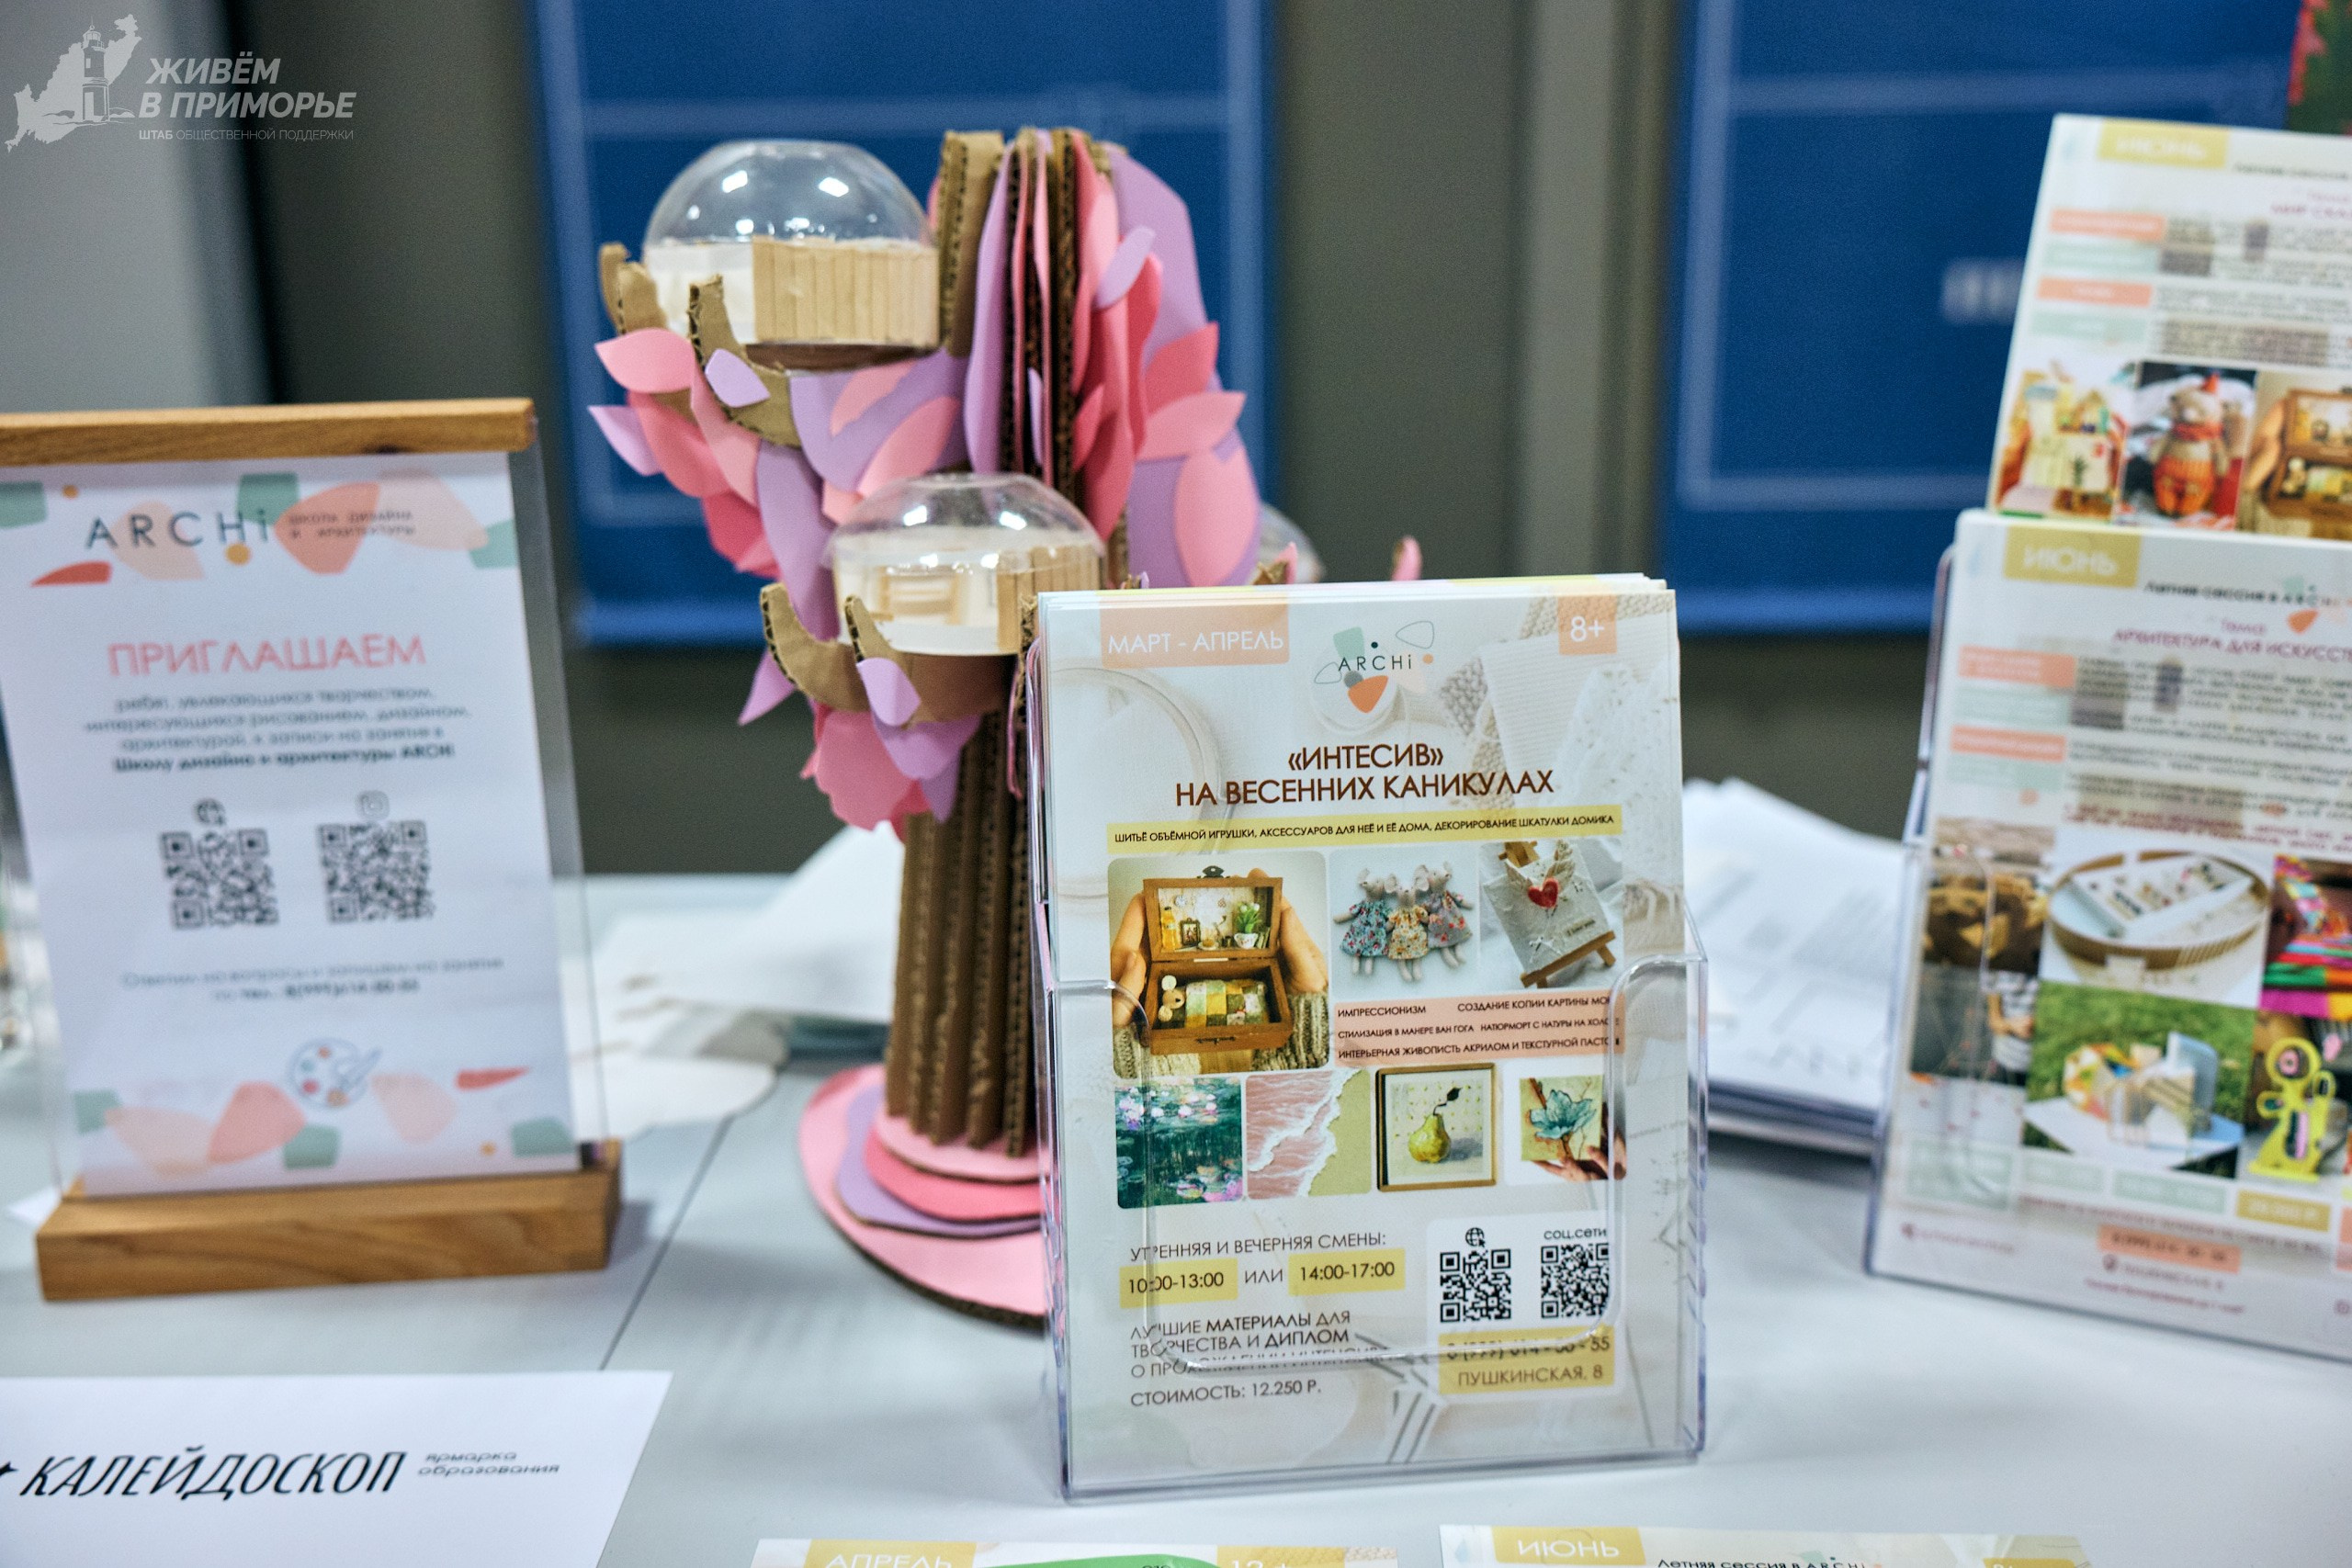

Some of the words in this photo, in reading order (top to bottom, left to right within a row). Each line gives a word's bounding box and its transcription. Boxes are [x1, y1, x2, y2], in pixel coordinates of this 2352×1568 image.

[1570, 615, 1605, 642] 8+
[1108, 632, 1171, 654] МАРТ
[1193, 629, 1284, 652] АПРЕЛЬ
[107, 634, 426, 676] ПРИГЛАШАЕМ
[1288, 742, 1444, 772] «ИНТЕСИВ»
[1176, 782, 1218, 807] НА
[1226, 776, 1375, 805] ВЕСЕННИХ
[1384, 769, 1555, 799] КАНИКУЛАХ
[1114, 831, 1148, 842] ШИТЬЁ
[1149, 829, 1206, 841] ОБЪЁМНОЙ
[1208, 828, 1258, 840] ИГРУШКИ,
[1260, 826, 1334, 838] АКСЕССУАРОВ
[1336, 825, 1356, 836] ДЛЯ
[1358, 822, 1374, 834] НЕЁ
[1376, 824, 1385, 832] И
[1385, 821, 1397, 832] ЕЁ
[1398, 821, 1432, 833] ДОМА,
[1434, 818, 1517, 831] ДЕКОРИРОВАНИЕ
[1519, 816, 1569, 828] ШКАТУЛКИ
[1571, 815, 1614, 826] ДОМИКА
[1338, 1005, 1427, 1018] ИМПРЕССИОНИЗМ
[1457, 1000, 1510, 1012] СОЗДАНИЕ
[1512, 998, 1545, 1009] КОПИИ
[1548, 997, 1589, 1008] КАРТИНЫ
[1338, 1028, 1393, 1039] СТИЛИЗАЦИЯ
[1402, 1026, 1434, 1035] МАНЕРЕ
[1436, 1025, 1452, 1034] ВАН
[1454, 1023, 1475, 1032] ГОГА
[1532, 1021, 1540, 1029] С
[1542, 1019, 1572, 1028] НАТУРЫ
[1575, 1018, 1585, 1026] НА
[1588, 1017, 1620, 1026] ХОЛС
[1339, 1047, 1400, 1059] ИНТЕРЬЕРНАЯ
[1403, 1044, 1461, 1055] ЖИВОПИСТЬ
[1464, 1042, 1510, 1053] АКРИЛОМ
[1512, 1042, 1519, 1050] И
[1521, 1037, 1577, 1049] ТЕКСТУРНОЙ
[1580, 1037, 1620, 1046] ПАСТО
[1544, 1228, 1607, 1240] соц.сети
[1131, 1242, 1211, 1261] УТЕННЯЯ
[1217, 1241, 1229, 1255] И
[1234, 1235, 1313, 1254] ВЕЧЕРНЯЯ
[1318, 1233, 1386, 1248] СМЕНЫ:
[1245, 1269, 1283, 1283] ИЛИ
[1301, 1261, 1395, 1280] 14:00-17:00
[1206, 1314, 1311, 1333] МАТЕРИАЛЫ
[1316, 1311, 1350, 1327] ДЛЯ
[1248, 1334, 1260, 1348] И
[1264, 1328, 1349, 1348] ДИПЛОМ
[1131, 1364, 1146, 1378] О
[1592, 1363, 1604, 1380] 8
[1131, 1385, 1246, 1406] СТОИМОСТЬ:
[1252, 1380, 1303, 1396] 12.250
[1307, 1379, 1321, 1393] Р.
[425, 1451, 517, 1463] ярмарка
[18, 1445, 407, 1501] КАЛЕЙДОСКОП
[417, 1464, 560, 1477] образования
[1517, 1539, 1620, 1558] ИЮНЬ
[825, 1554, 952, 1568] АПРЕЛЬ
